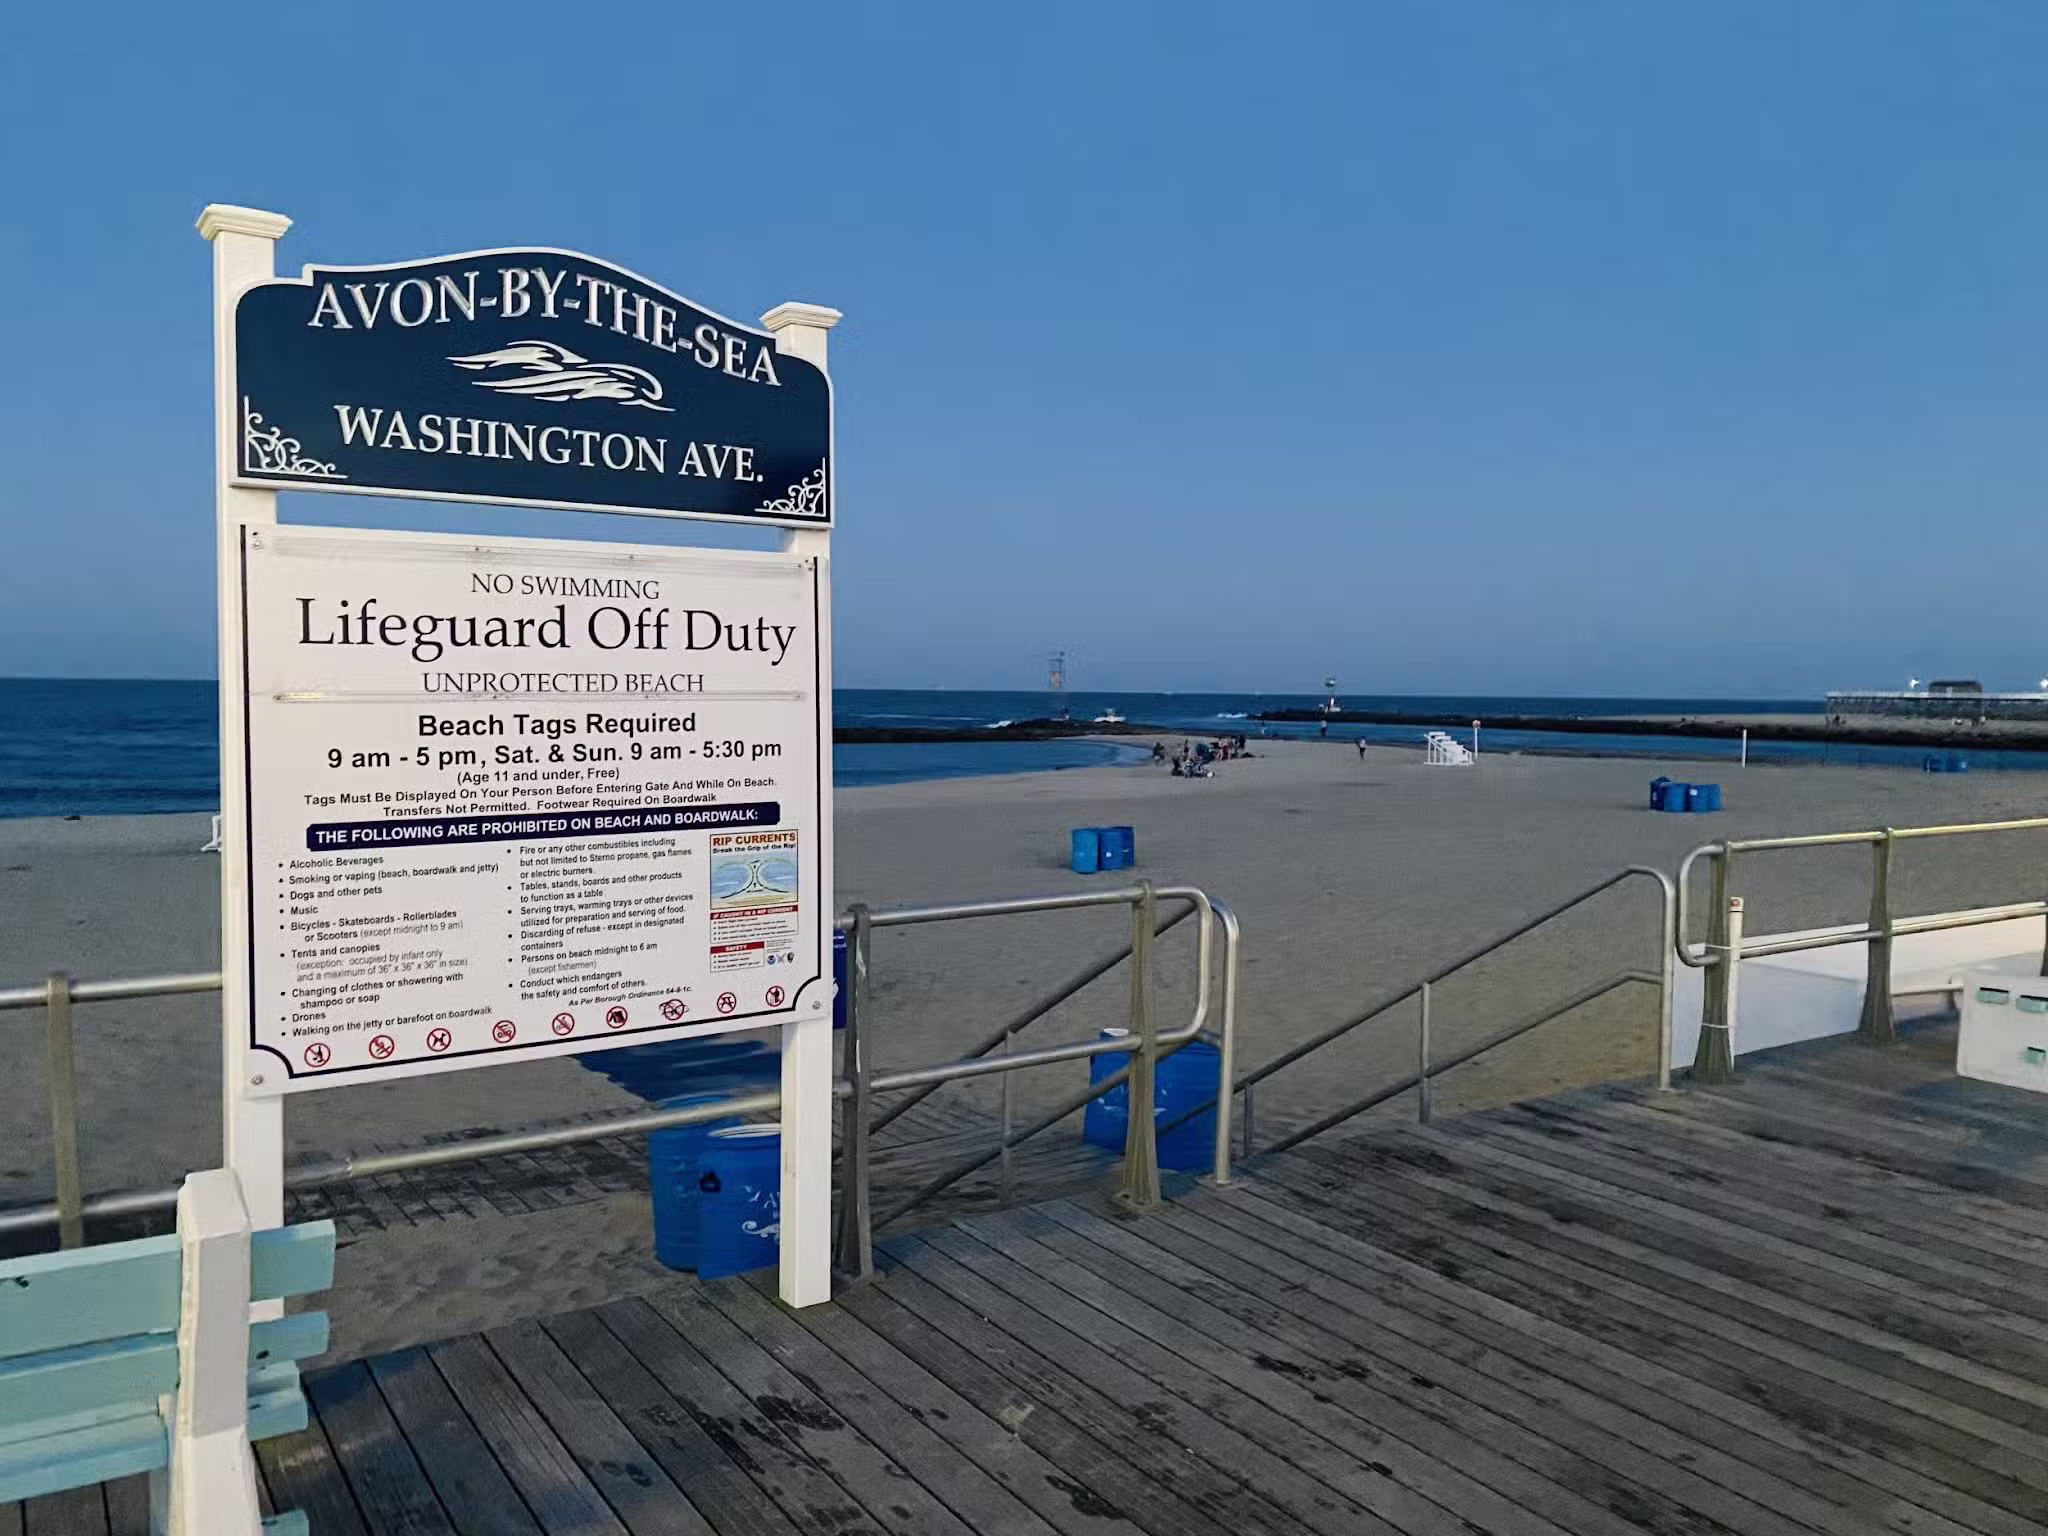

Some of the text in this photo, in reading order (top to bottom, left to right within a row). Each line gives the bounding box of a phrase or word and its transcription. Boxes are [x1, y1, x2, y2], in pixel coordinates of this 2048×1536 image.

[307, 268, 783, 388] AVON-BY-THE-SEA
[333, 404, 763, 482] WASHINGTON AVE.
[471, 573, 659, 599] NO SWIMMING
[298, 597, 796, 666] Lifeguard Off Duty
[423, 672, 703, 694] UNPROTECTED BEACH
[418, 712, 695, 739] Beach Tags Required
[327, 748, 342, 768] 9
[351, 752, 389, 768] am
[416, 746, 429, 766] 5
[439, 750, 485, 770] pm,
[494, 745, 539, 764] Sat.
[548, 743, 564, 762] &
[572, 743, 622, 762] Sun.
[630, 742, 642, 760] 9
[650, 745, 681, 759] am
[703, 740, 744, 758] 5:30
[751, 743, 781, 761] pm
[457, 767, 619, 786] (Age 11 and under, Free)
[303, 794, 335, 807] Tags
[340, 793, 371, 803] Must
[375, 792, 391, 802] Be
[395, 789, 456, 803] Displayed
[459, 788, 476, 798] On
[480, 787, 509, 798] Your
[512, 786, 552, 796] Person
[556, 784, 592, 794] Before
[596, 783, 641, 793] Entering
[645, 781, 669, 791] Gate
[672, 780, 693, 790] And
[695, 779, 724, 789] While
[726, 778, 741, 787] On
[383, 805, 442, 816] Transfers
[446, 804, 466, 814] Not
[537, 800, 591, 812] Footwear
[590, 795, 642, 811] Required
[641, 795, 660, 809] On
[659, 792, 719, 808] Boardwalk
[315, 808, 757, 843] THE FOLLOWING ARE PROHIBITED ON BEACH AND BOARDWALK:
[519, 845, 535, 854] Fire
[547, 845, 563, 854] any
[564, 843, 585, 852] other
[587, 839, 639, 850] combustibles
[640, 837, 675, 850] including
[712, 832, 796, 846] RIP CURRENTS
[289, 856, 383, 869] Alcoholic Beverages
[519, 858, 533, 866] but
[535, 857, 548, 865] not
[550, 854, 577, 864] limited
[589, 853, 615, 862] Sterno
[651, 850, 666, 859] gas
[667, 848, 692, 856] flames
[289, 874, 330, 884] Smoking
[344, 871, 375, 881] vaping
[412, 865, 457, 876] boardwalk
[459, 864, 475, 873] and
[476, 863, 498, 874] jetty)
[520, 871, 682, 890] Tables, stands, boards and other products
[290, 885, 382, 901] Dogs and other pets
[290, 905, 318, 915] Music
[290, 919, 330, 931] Bicycles
[338, 914, 394, 927] Skateboards
[403, 909, 456, 921] Rollerblades
[520, 928, 564, 939] Discarding
[565, 926, 574, 934] of
[576, 924, 600, 934] refuse
[607, 921, 633, 930] except
[634, 920, 641, 928] in
[643, 915, 684, 927] designated
[290, 943, 380, 958] Tents and canopies
[521, 953, 554, 963] Persons
[568, 948, 592, 958] beach
[594, 944, 628, 955] midnight
[629, 944, 637, 952] to
[639, 942, 644, 950] 6
[291, 972, 463, 997] Changing of clothes or showering with
[519, 970, 622, 988] Conduct which endangers
[300, 994, 379, 1009] shampoo or soap
[292, 1012, 326, 1022] Drones
[292, 1006, 491, 1037] Walking on the jetty or barefoot on boardwalk
